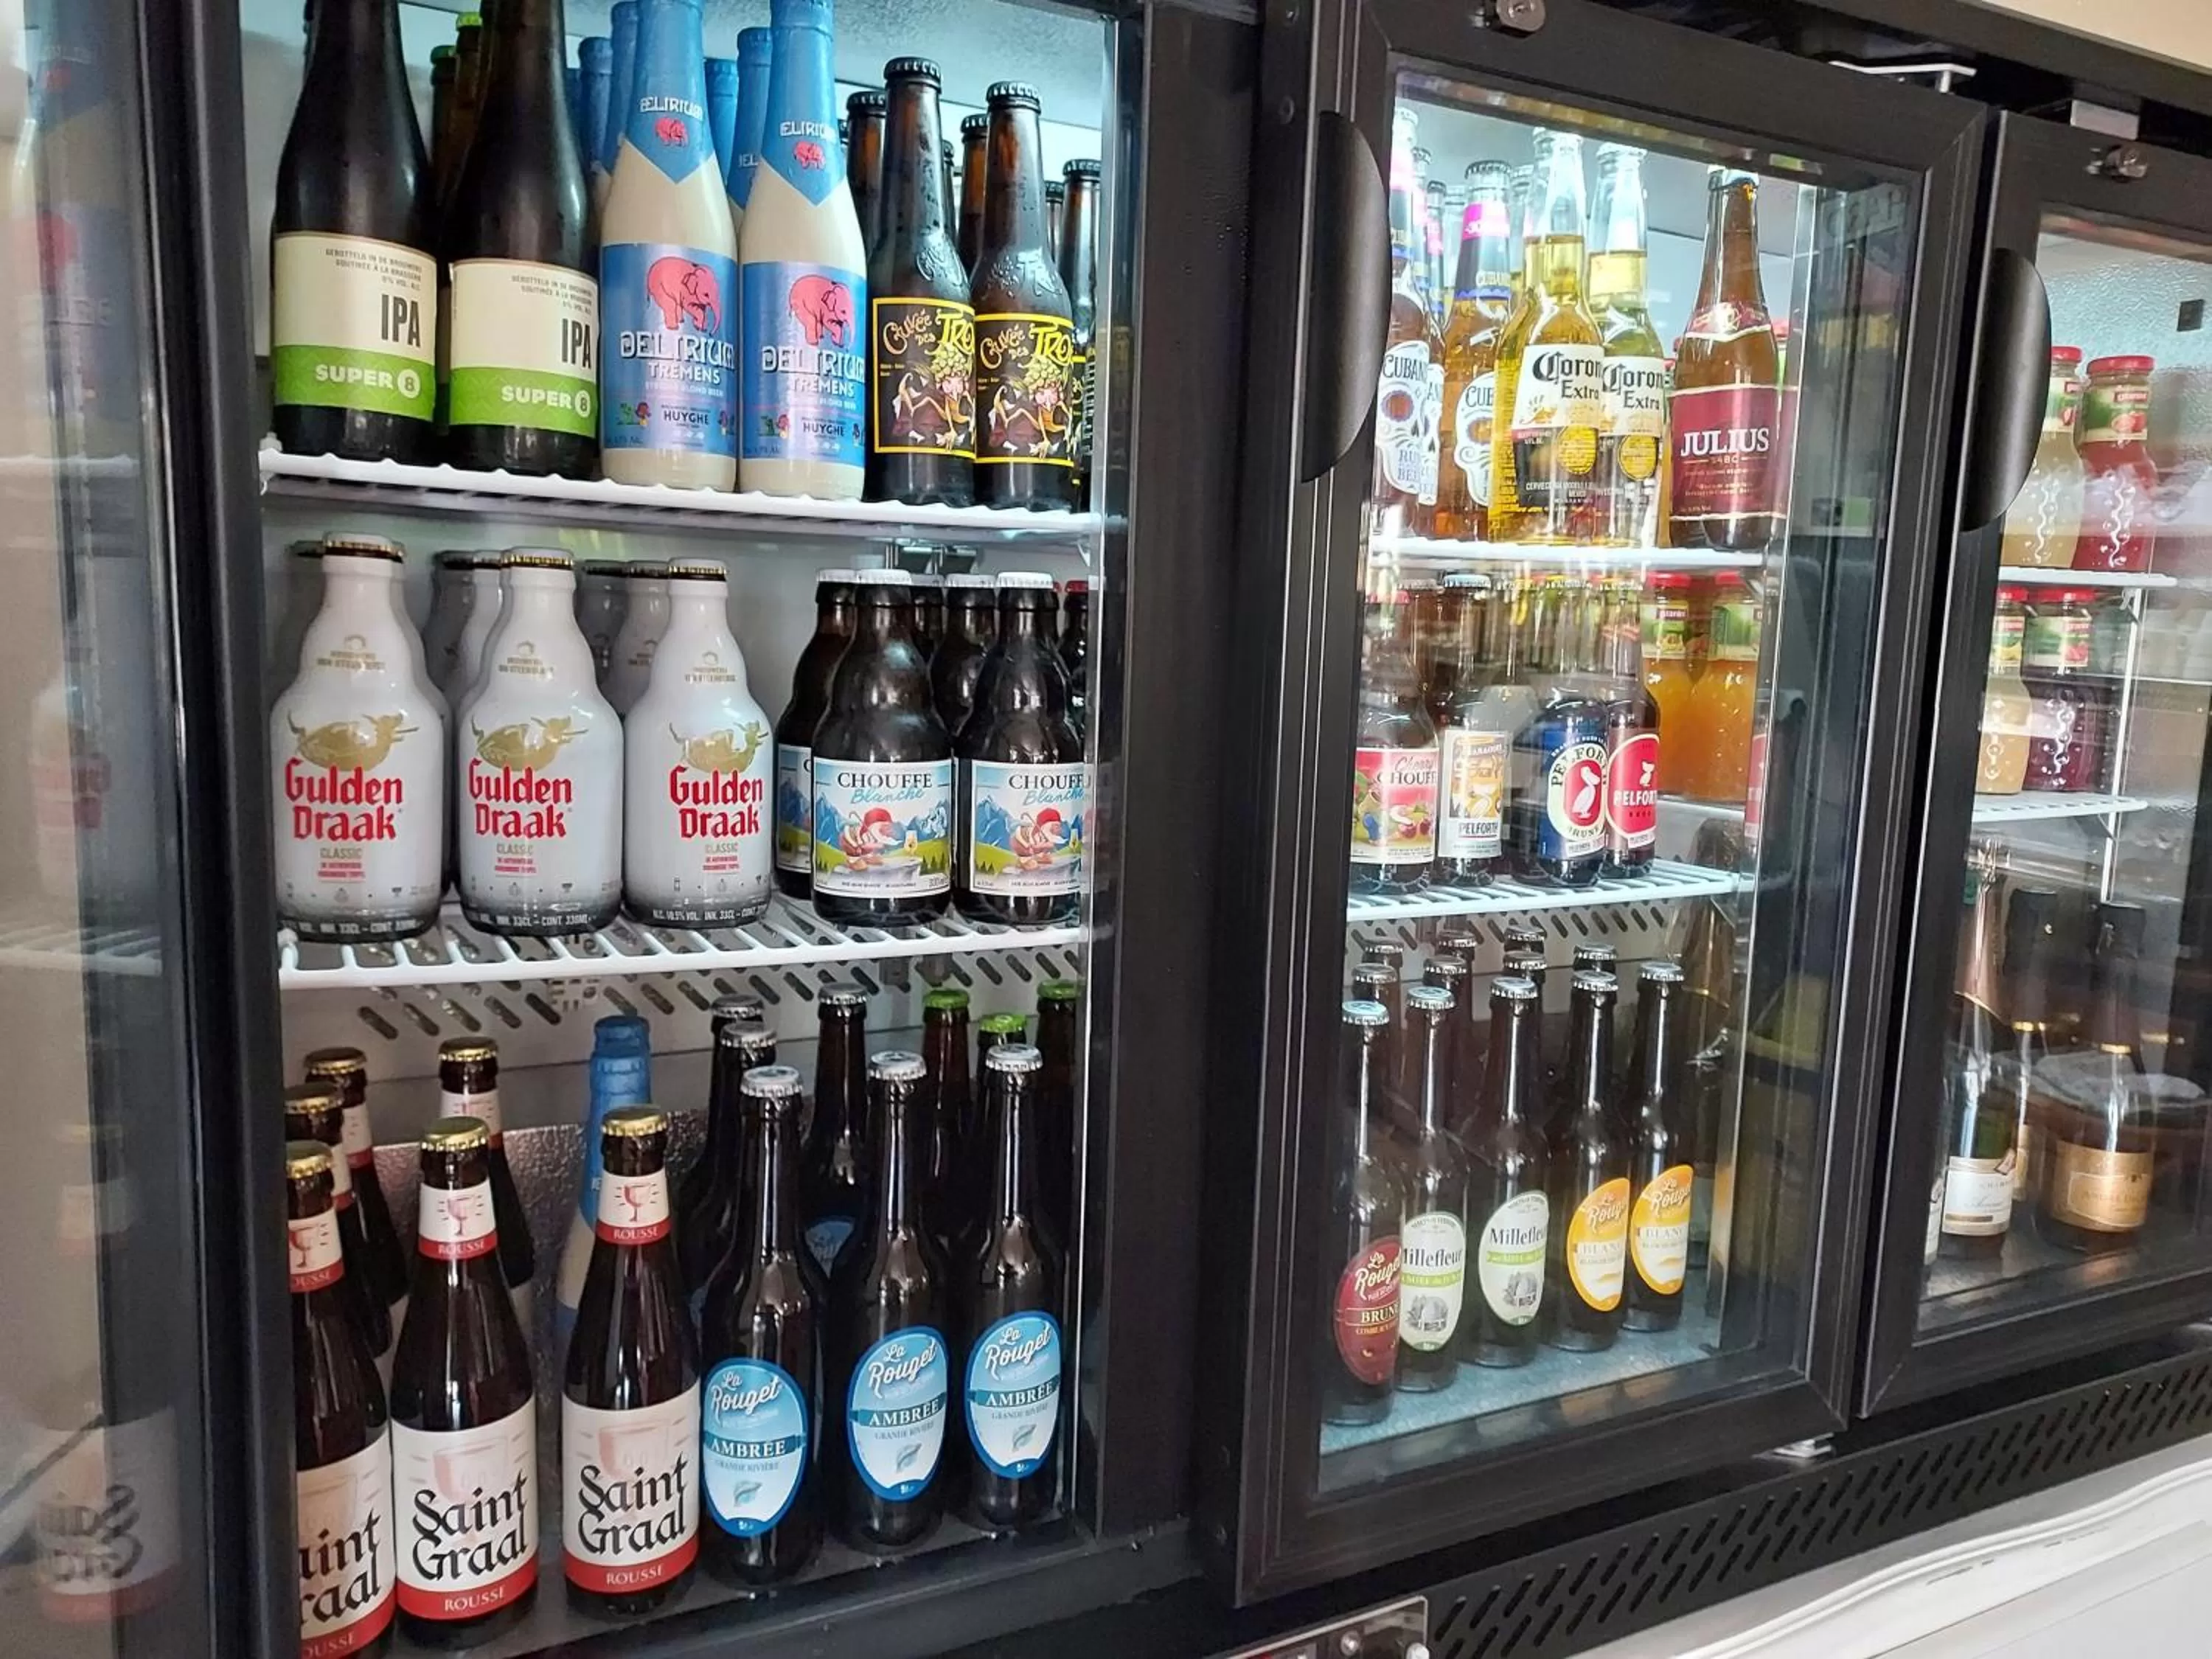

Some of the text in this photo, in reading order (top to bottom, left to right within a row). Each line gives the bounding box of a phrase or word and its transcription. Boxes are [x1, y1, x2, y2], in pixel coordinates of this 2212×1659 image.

[381, 293, 421, 348] IPA
[561, 318, 591, 369] IPA
[316, 364, 394, 391] SUPER
[647, 362, 721, 385] TREMENS
[501, 384, 572, 409] SUPER
[792, 377, 855, 399] TREMENS
[1561, 379, 1599, 400] Extra
[664, 409, 709, 425] HUYGHE
[803, 422, 844, 437] HUYGHE
[1680, 428, 1770, 456] JULIUS
[284, 757, 403, 804] Gulden
[467, 757, 572, 804] Gulden
[669, 765, 763, 807] Gulden
[836, 771, 933, 790] CHOUFFE
[849, 786, 925, 804] Blanche
[292, 804, 397, 842] Draak
[474, 803, 567, 839] Draak
[680, 802, 760, 840] Draak
[613, 1225, 658, 1240] ROUSSE
[1368, 1252, 1386, 1269] La
[999, 1326, 1021, 1346] La
[883, 1343, 906, 1363] La
[984, 1321, 1051, 1382] Rouget
[721, 1370, 743, 1391] La
[868, 1337, 936, 1399] Rouget
[710, 1374, 782, 1425] Rouget
[577, 1451, 689, 1514] Saint
[412, 1465, 529, 1538] Saint
[577, 1497, 686, 1556] Graal
[412, 1515, 529, 1582] Graal
[606, 1564, 665, 1587] ROUSSE
[444, 1587, 506, 1613] ROUSSE
